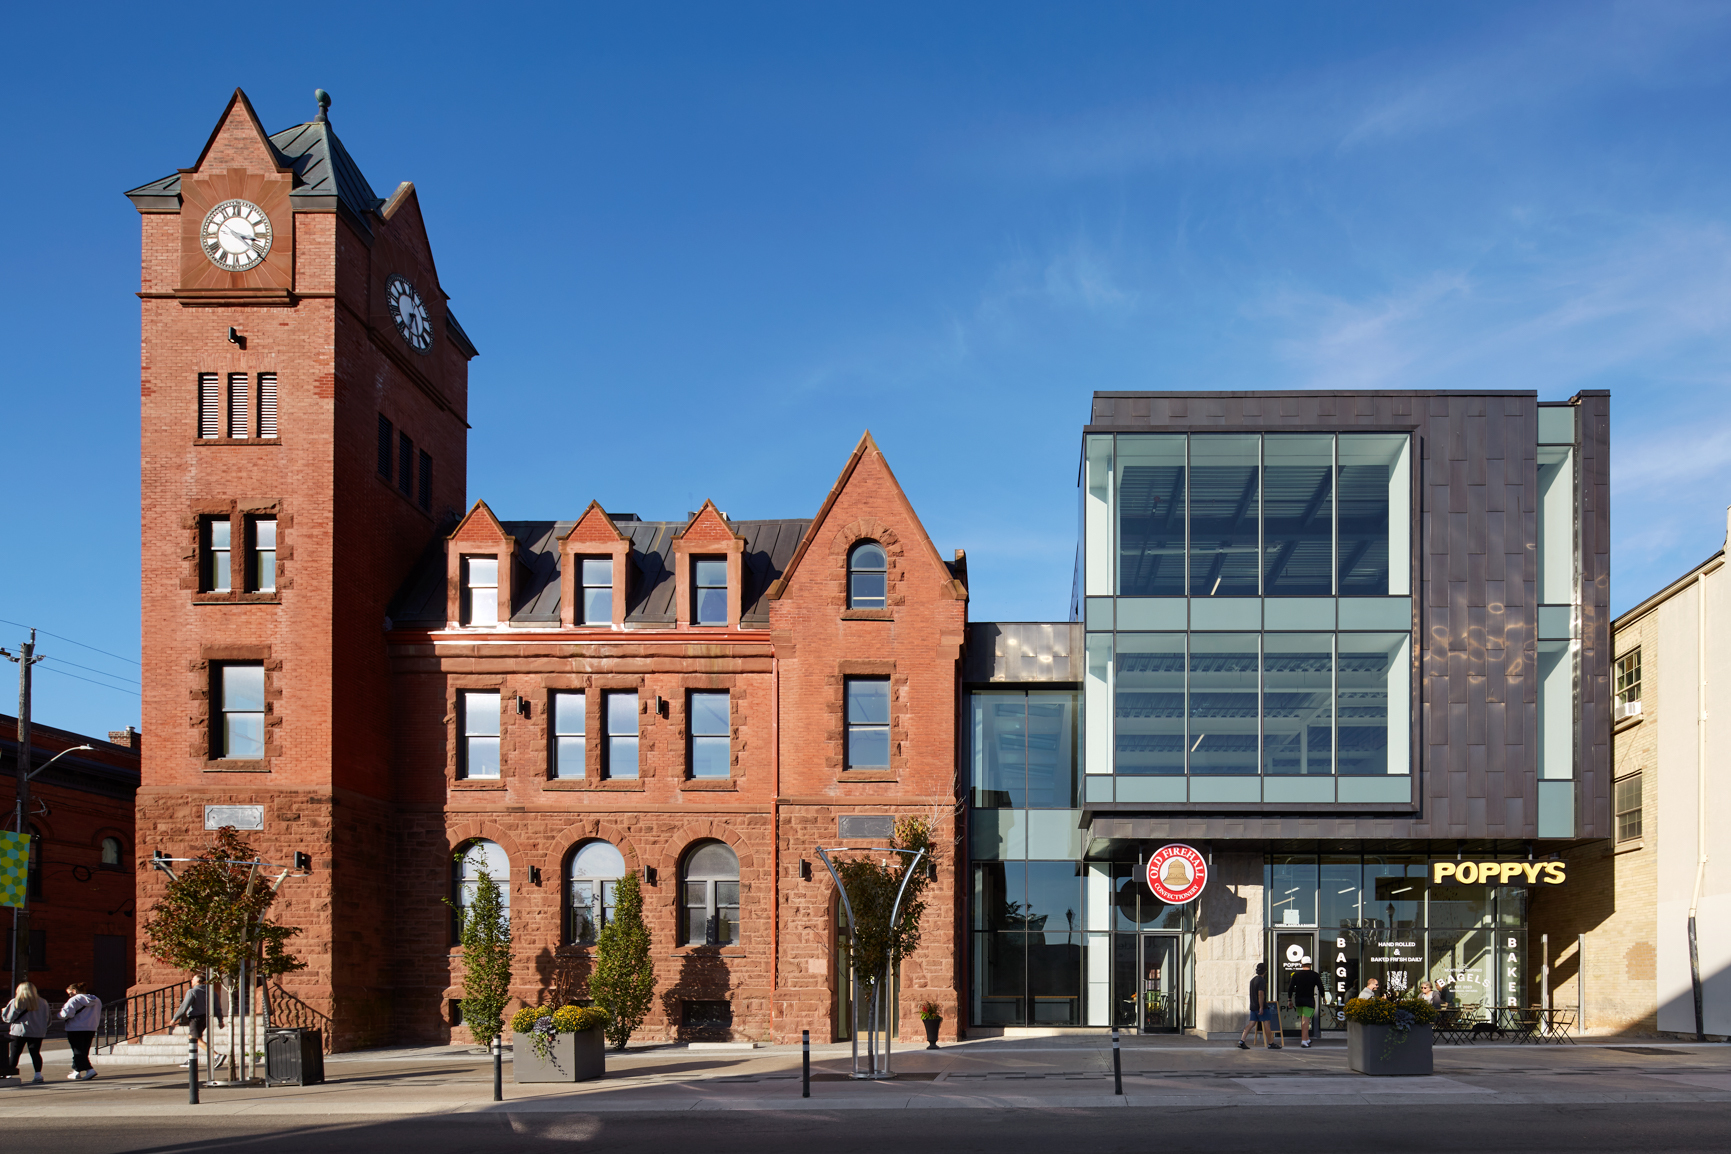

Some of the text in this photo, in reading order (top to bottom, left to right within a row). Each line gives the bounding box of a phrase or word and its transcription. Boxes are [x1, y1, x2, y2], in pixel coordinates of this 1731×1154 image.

[1150, 847, 1205, 880] OLD FIREHALL
[1154, 883, 1199, 900] CONFECTIONERY
[1393, 948, 1400, 956] &
[1336, 937, 1347, 1021] BAGELS
[1436, 973, 1491, 988] BAGELS
